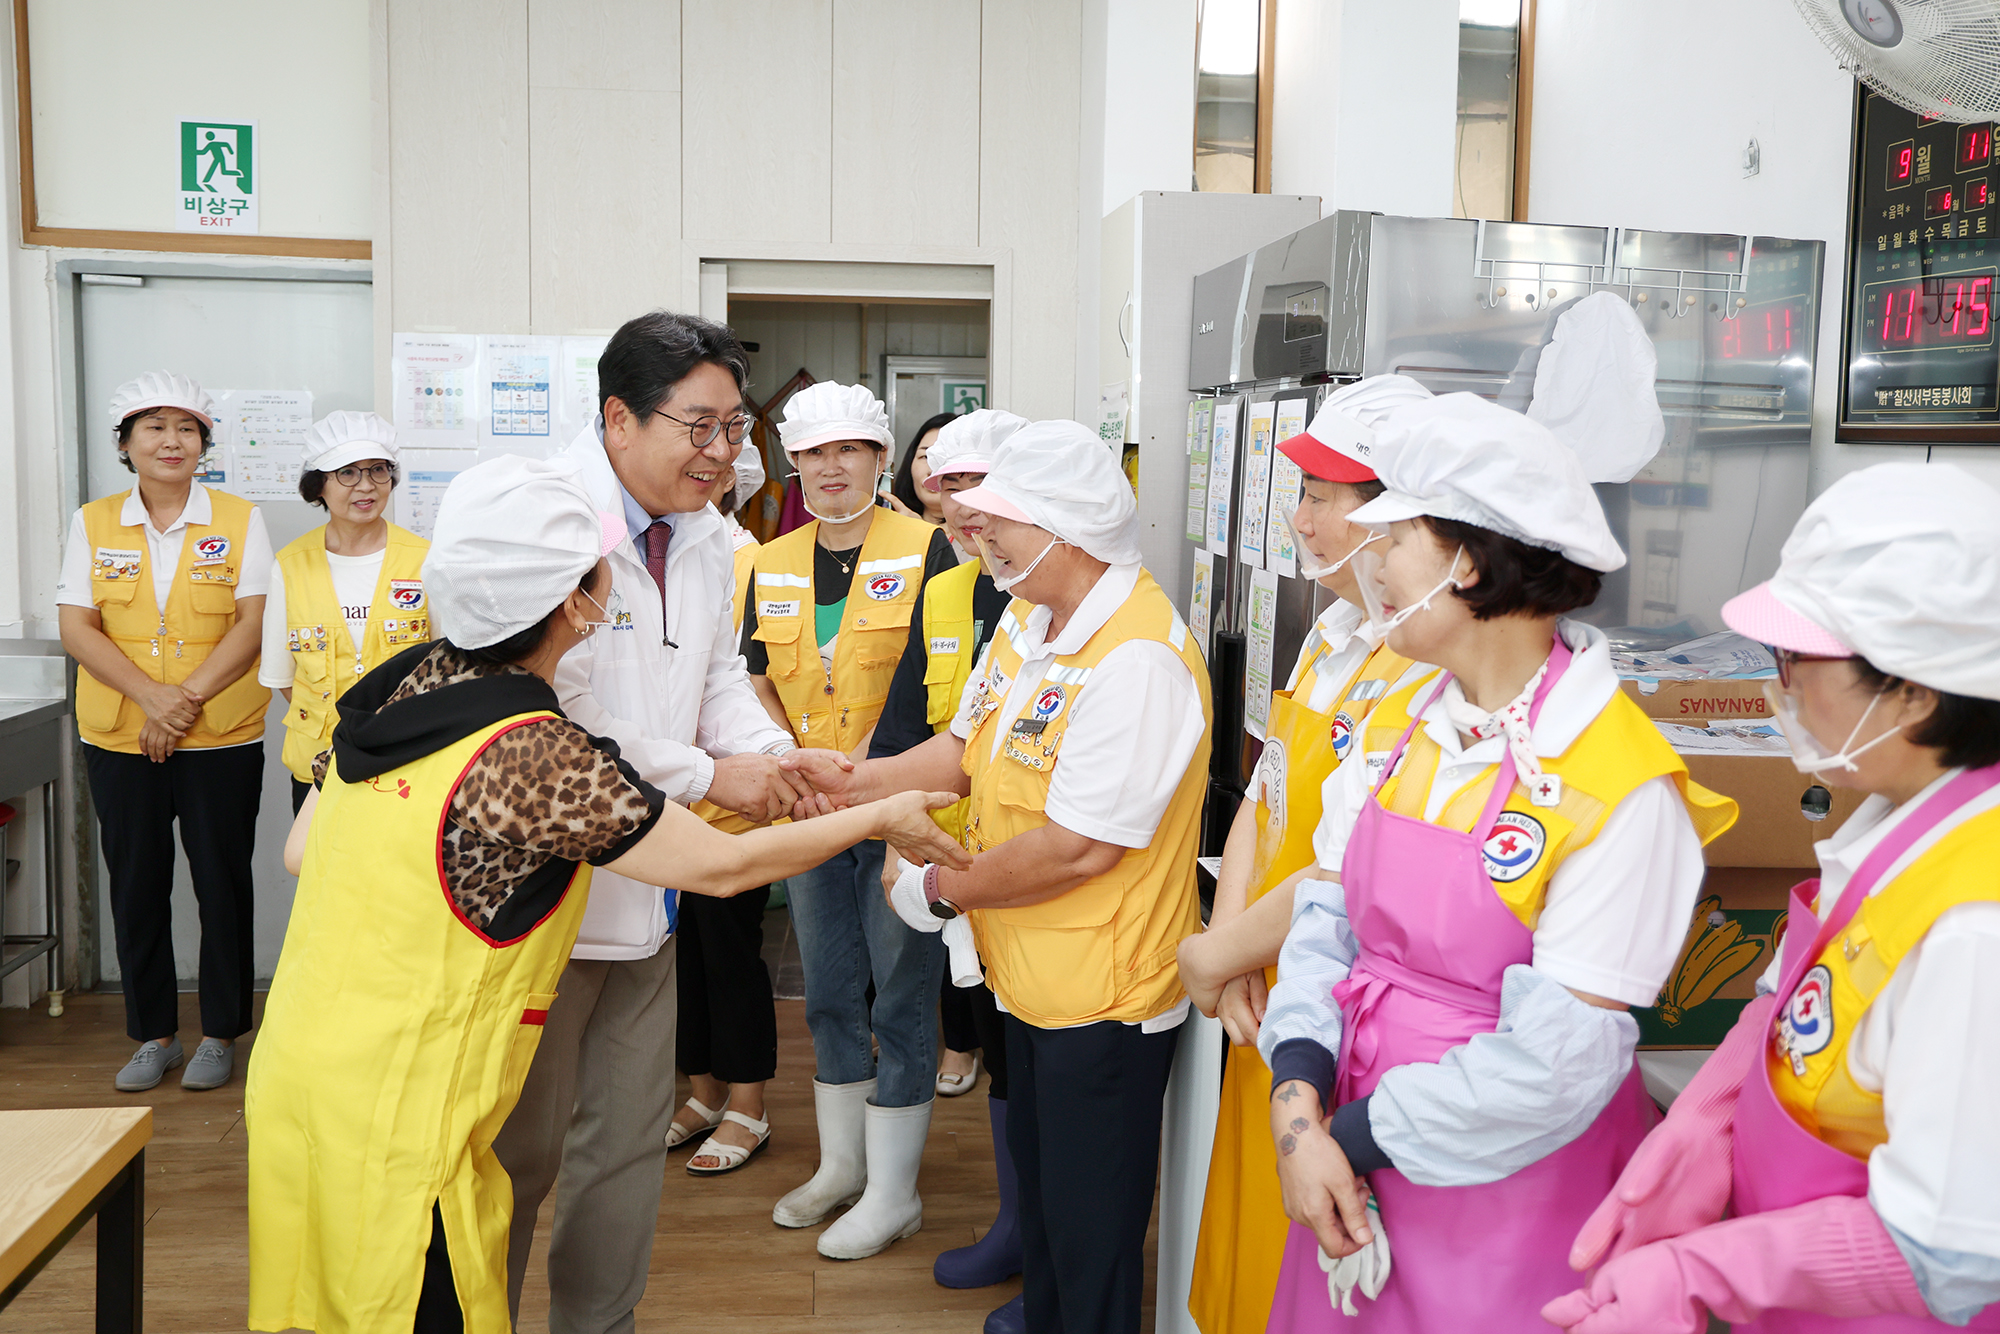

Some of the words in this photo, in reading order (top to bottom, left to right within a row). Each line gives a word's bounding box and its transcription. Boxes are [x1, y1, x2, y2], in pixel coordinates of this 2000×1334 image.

[1899, 148, 1911, 178] 9
[1916, 144, 1931, 176] 월
[184, 196, 249, 216] 비상구
[200, 216, 233, 227] EXIT
[1877, 234, 1887, 251] 일
[1893, 232, 1902, 249] 월
[1908, 229, 1918, 245] 화
[1924, 226, 1935, 242] 수
[1941, 222, 1951, 239] 목
[1958, 219, 1969, 237] 금
[1975, 216, 1987, 234] 토
[1882, 290, 1916, 341] 11
[1952, 277, 1992, 335] 15
[1894, 386, 1972, 406] 칠산서부동봉사회
[1680, 698, 1765, 714] BANANAS
[1517, 816, 1532, 829] RED
